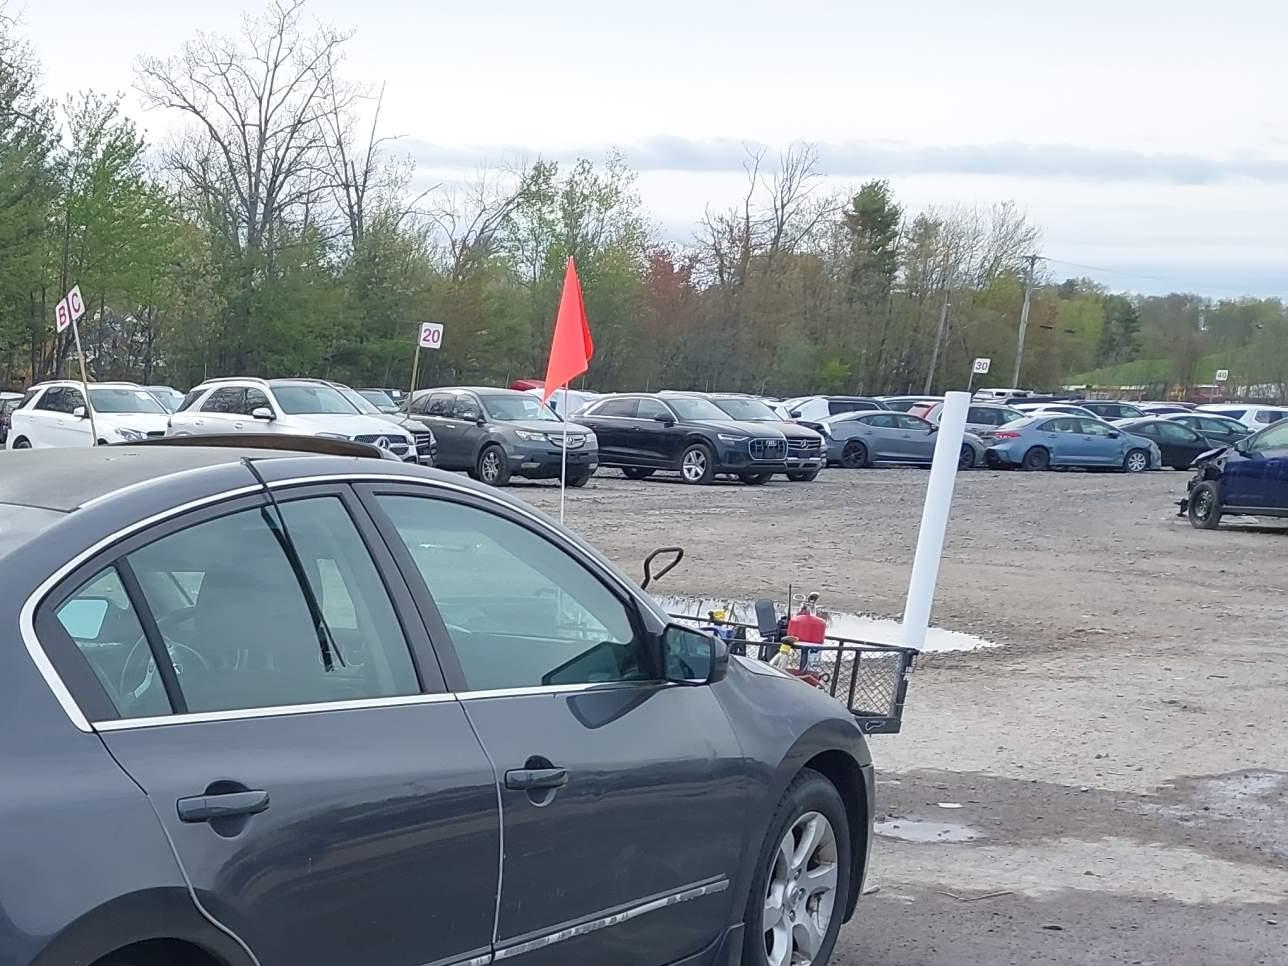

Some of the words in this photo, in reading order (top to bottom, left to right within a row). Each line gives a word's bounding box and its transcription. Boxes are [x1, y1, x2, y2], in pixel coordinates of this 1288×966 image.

[71, 291, 81, 314] C
[58, 305, 67, 327] B
[422, 328, 441, 343] 20
[975, 361, 989, 371] 30
